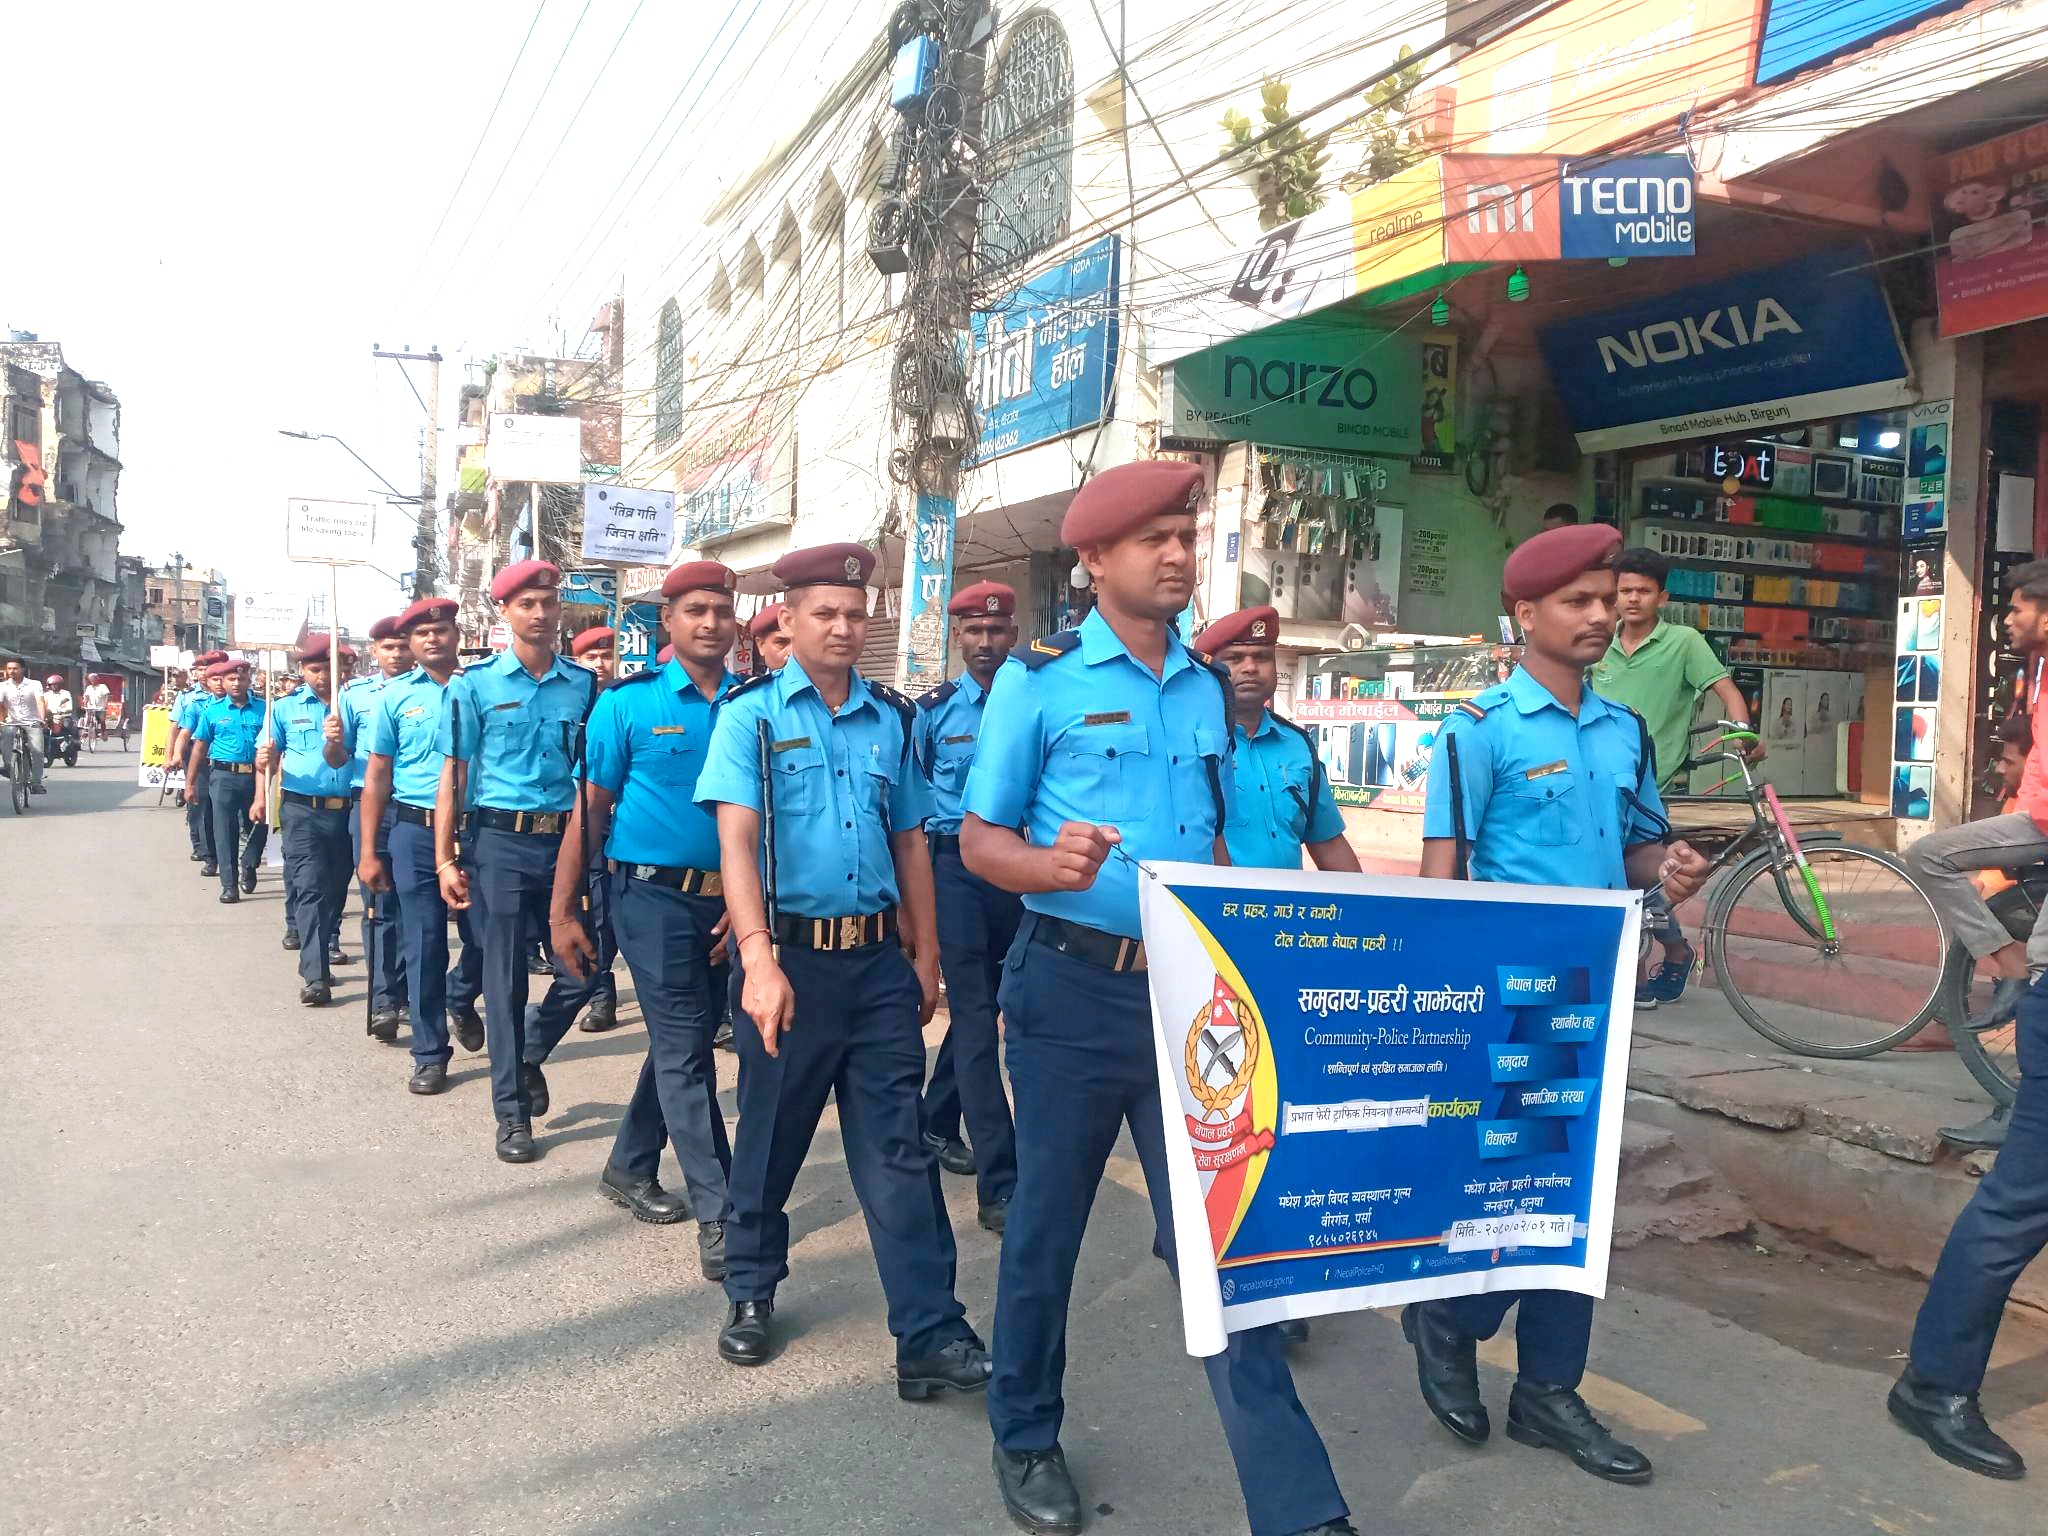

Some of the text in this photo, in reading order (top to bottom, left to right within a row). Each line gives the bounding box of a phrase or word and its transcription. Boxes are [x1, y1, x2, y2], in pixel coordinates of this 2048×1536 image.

[1563, 177, 1692, 215] TECNO
[1369, 209, 1423, 246] realme
[1596, 297, 1804, 374] NOKIA
[1224, 354, 1378, 410] narzo
[1186, 409, 1202, 422] BY
[1691, 414, 1723, 430] Mobile
[1751, 405, 1791, 424] Birgunj
[637, 506, 657, 521] गति
[1222, 902, 1238, 917] हर
[1297, 906, 1306, 919] र
[1274, 930, 1294, 948] टोल
[1332, 932, 1358, 949] नेपाल
[1362, 933, 1386, 952] प्रहरी
[1506, 974, 1557, 993] नेपाल प्रहरी
[1551, 1014, 1595, 1031] स्थानीय तह
[1304, 1026, 1472, 1051] Community-Police Partnership
[1497, 1055, 1529, 1071] समुदाय
[1521, 1088, 1585, 1107] सामाजिक संस्था
[1290, 1109, 1313, 1123] प्रभात
[1316, 1107, 1330, 1121] फेरी
[1333, 1106, 1361, 1123] ट्राफिक
[1395, 1102, 1424, 1117] सम्बन्धी
[1484, 1130, 1518, 1146] विद्यालय
[1464, 1172, 1572, 1195] मधेश प्रदेश प्रहरी कार्यालय
[1279, 1190, 1301, 1209] मधेश
[1304, 1189, 1326, 1208] प्रदेश
[1351, 1188, 1391, 1204] व्यवस्थापन
[1393, 1187, 1412, 1205] गुल्म
[1520, 1196, 1545, 1212] धनुषा
[1355, 1206, 1373, 1224] पर्सा
[1308, 1228, 1378, 1248] ९८५५०२६९४५
